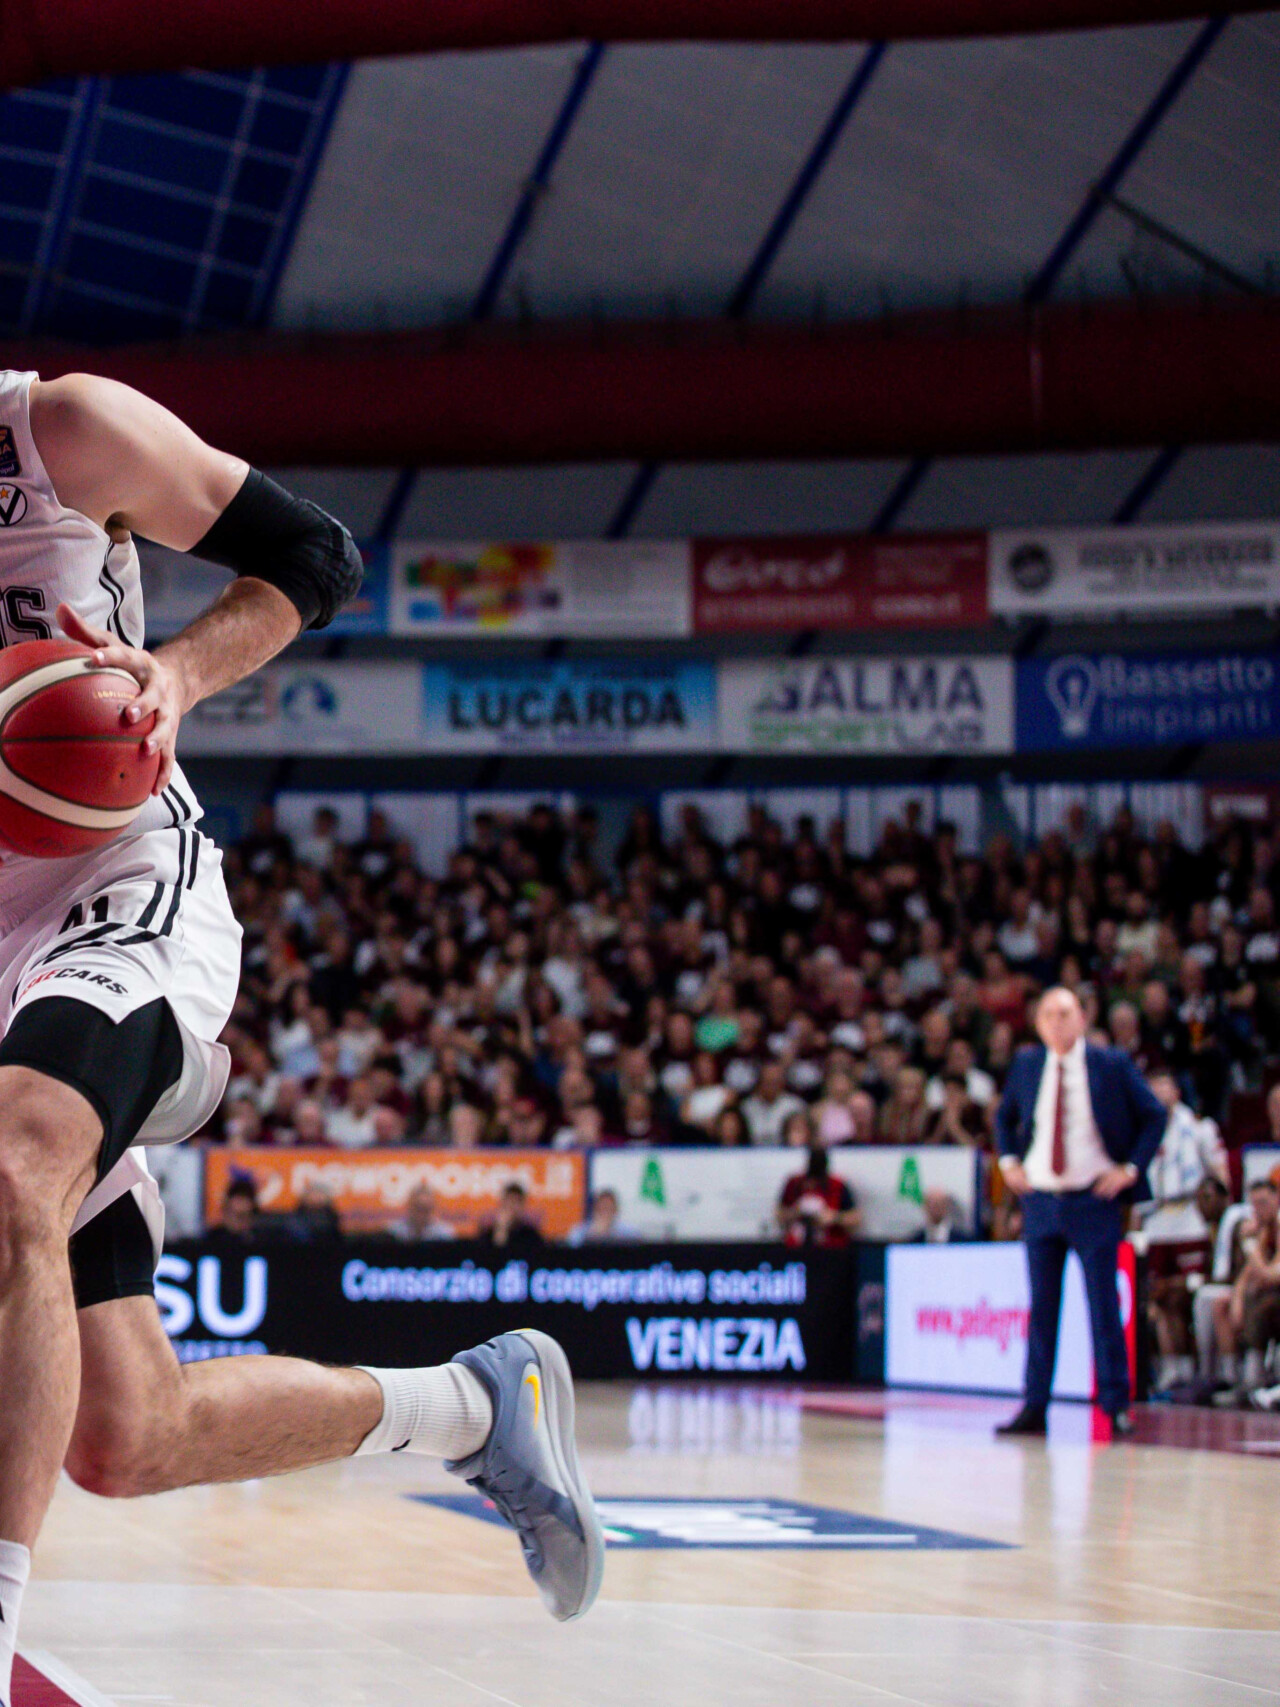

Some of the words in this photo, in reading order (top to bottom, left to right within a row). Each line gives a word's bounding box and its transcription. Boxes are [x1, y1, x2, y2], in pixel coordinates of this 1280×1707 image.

[446, 687, 687, 732] LUCARDA
[342, 1258, 493, 1302] Consorzio
[495, 1258, 528, 1302] di
[530, 1261, 706, 1311] cooperative
[707, 1262, 808, 1304] sociali
[624, 1316, 808, 1371] VENEZIA
